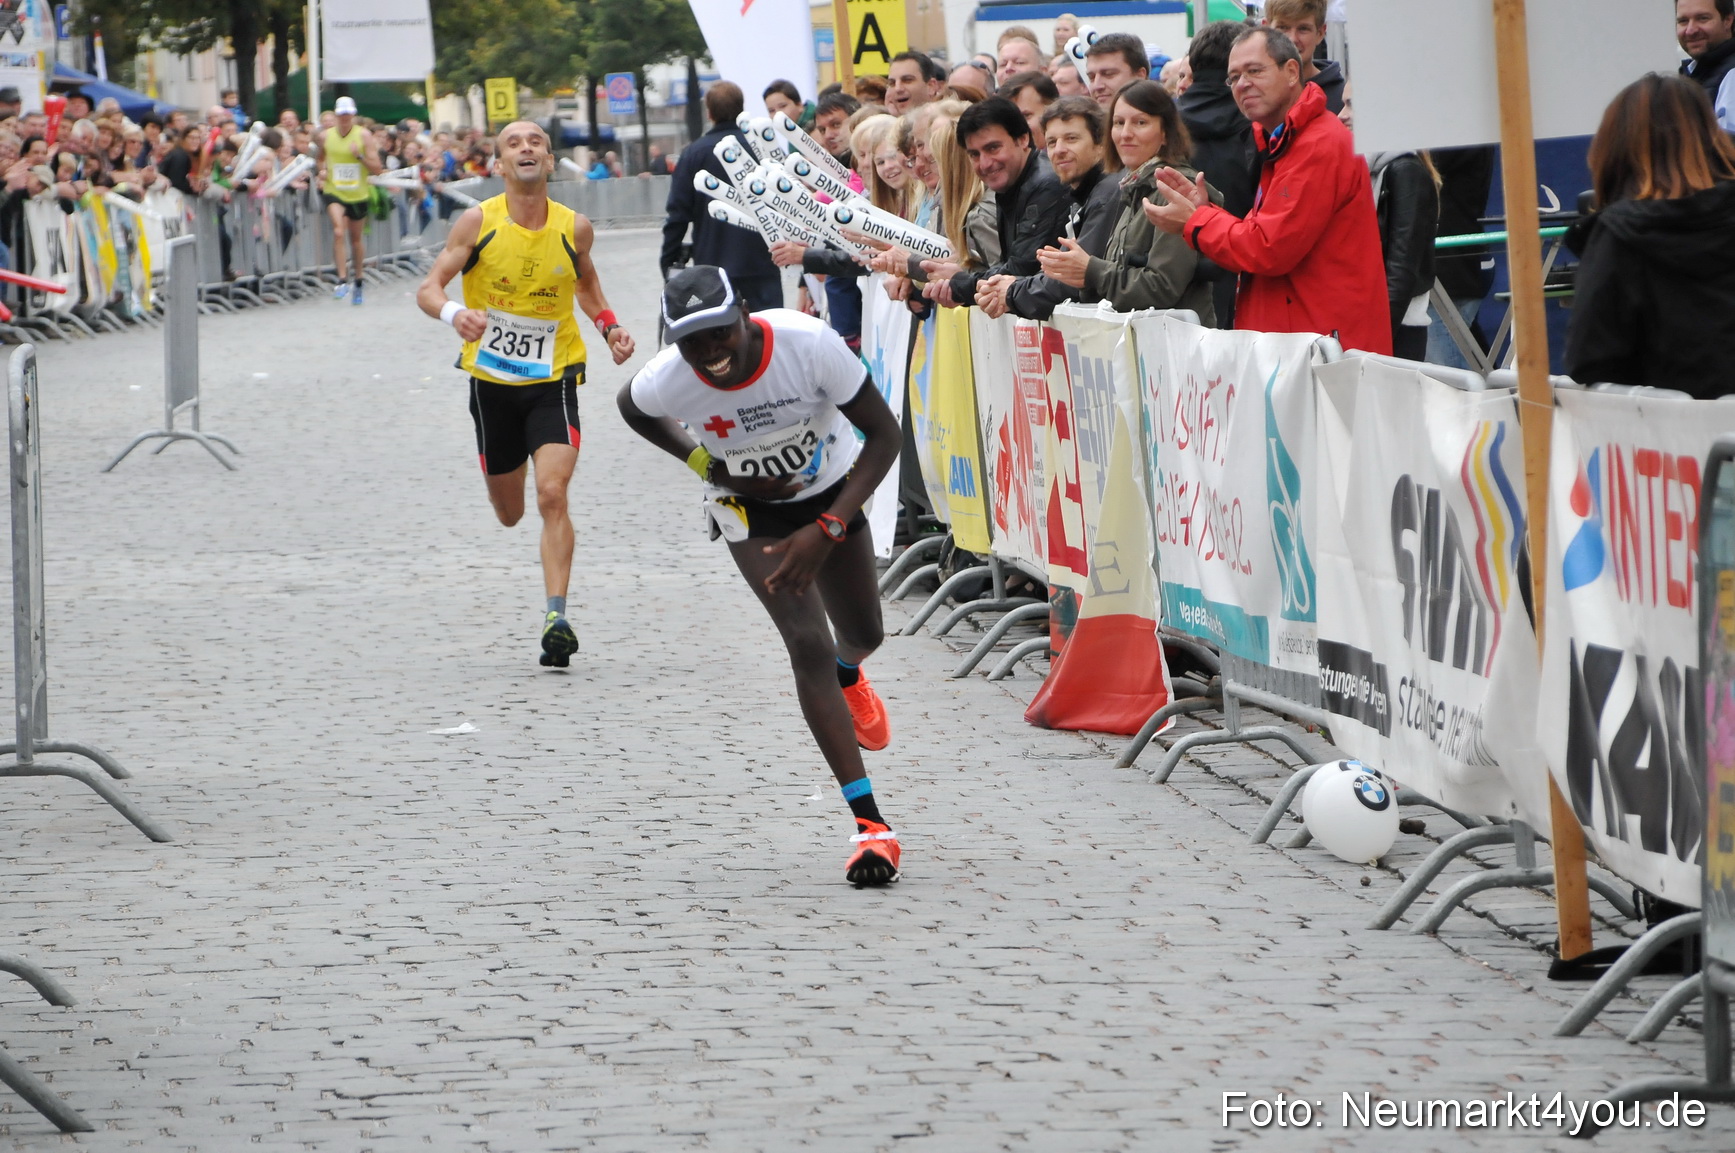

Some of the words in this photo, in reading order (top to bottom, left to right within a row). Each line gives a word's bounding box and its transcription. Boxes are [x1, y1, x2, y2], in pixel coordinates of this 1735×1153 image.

[853, 12, 890, 64] A
[814, 173, 850, 202] BMW
[510, 321, 545, 332] Neumarkt
[488, 326, 546, 360] 2351
[740, 410, 773, 425] Rotes
[744, 418, 777, 433] Kreuz
